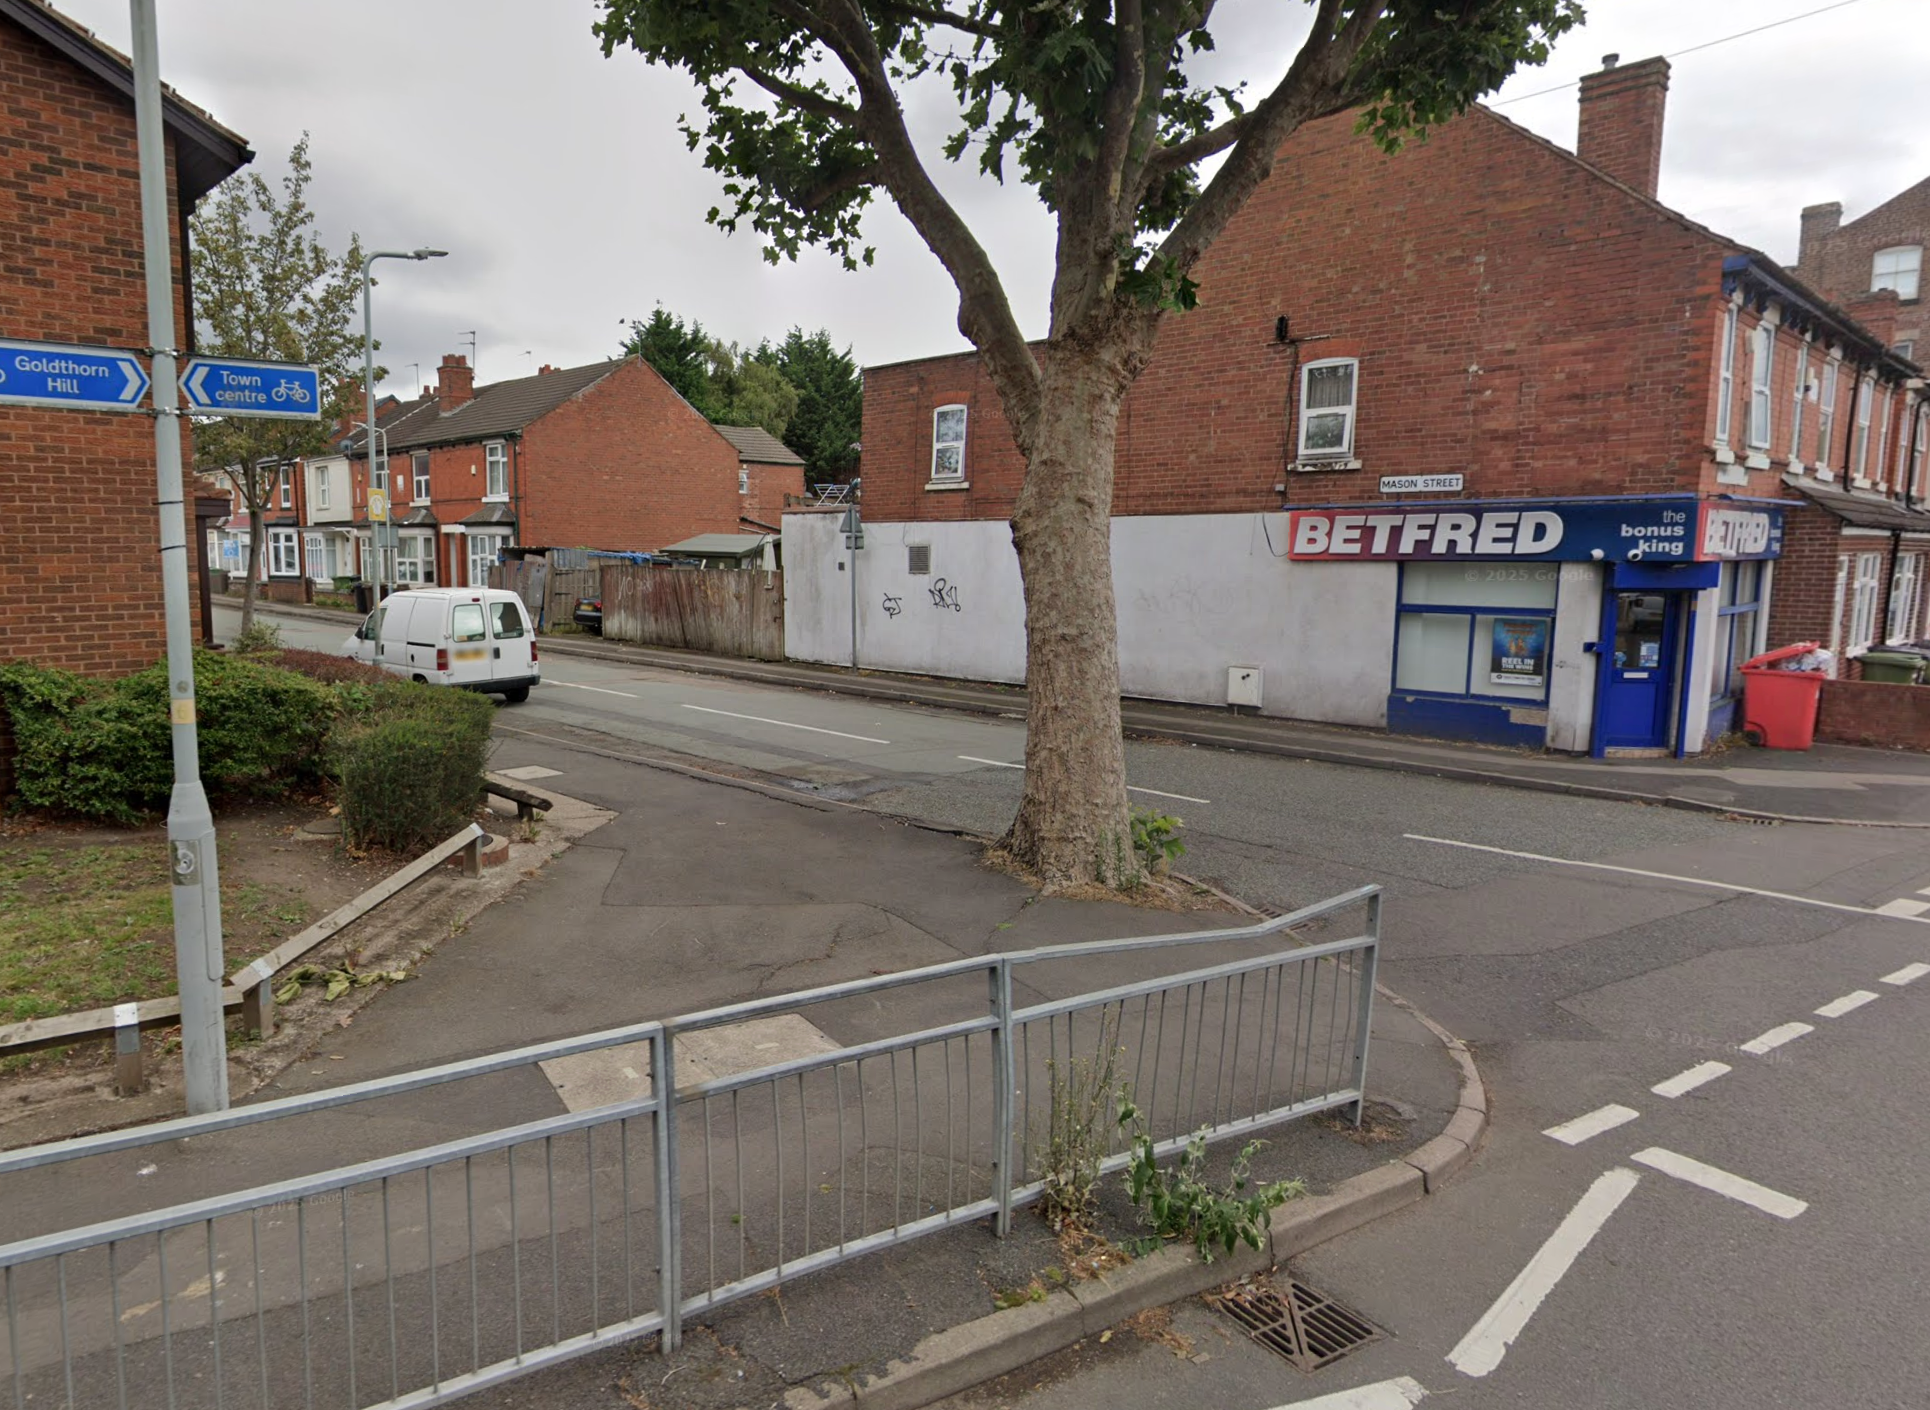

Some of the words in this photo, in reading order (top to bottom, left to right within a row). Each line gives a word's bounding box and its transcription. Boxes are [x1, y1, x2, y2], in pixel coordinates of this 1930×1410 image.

[15, 355, 109, 377] Goldthorn
[47, 377, 80, 394] Hill
[220, 370, 261, 387] Town
[215, 389, 267, 403] centre
[1382, 480, 1418, 489] MASON
[1423, 478, 1461, 488] STREET
[1663, 510, 1686, 523] the
[1293, 511, 1564, 555] BETFRED
[1621, 524, 1685, 537] bonus
[1703, 509, 1770, 555] BETFRED
[1638, 539, 1684, 556] king
